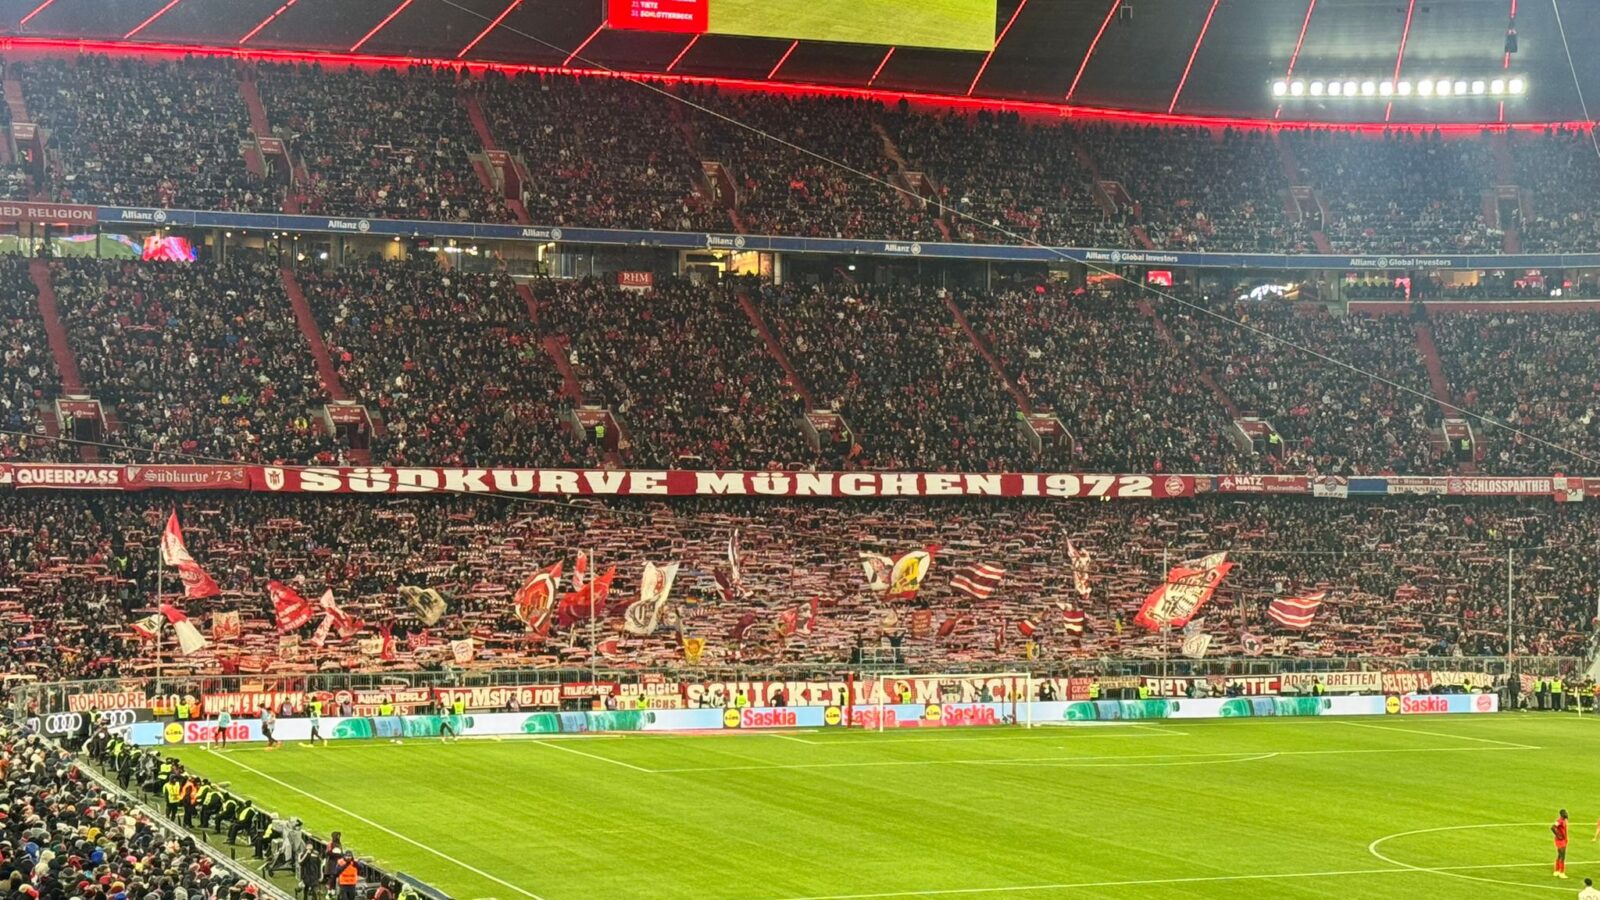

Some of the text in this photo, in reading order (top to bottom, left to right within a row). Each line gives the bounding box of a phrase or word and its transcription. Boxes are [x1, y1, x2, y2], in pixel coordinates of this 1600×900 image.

[0, 207, 93, 220] ED RELIGION
[121, 210, 153, 220] Allianz
[328, 220, 357, 229] Allianz
[521, 229, 550, 238] Allianz
[706, 237, 733, 246] Allianz
[885, 244, 910, 252] Allianz
[1086, 252, 1178, 262] Allianz Global Investors
[1350, 258, 1452, 267] Allianz Global Investors
[623, 272, 649, 283] RHM
[17, 469, 119, 484] QUEERPASS
[144, 469, 232, 482] Südkurve '73
[1234, 476, 1262, 485] NATZ
[300, 468, 1153, 497] SÜDKURVE MÜNCHEN 1972
[1465, 480, 1550, 492] SCHLOSSPANTHER
[1326, 674, 1376, 686] BRETTEN
[1382, 673, 1418, 692] SELTERS
[535, 687, 560, 704] rot
[69, 693, 144, 711] ROHRDORF
[1402, 697, 1448, 712] Saskia
[743, 709, 797, 726] Saskia
[944, 704, 995, 722] Saskia
